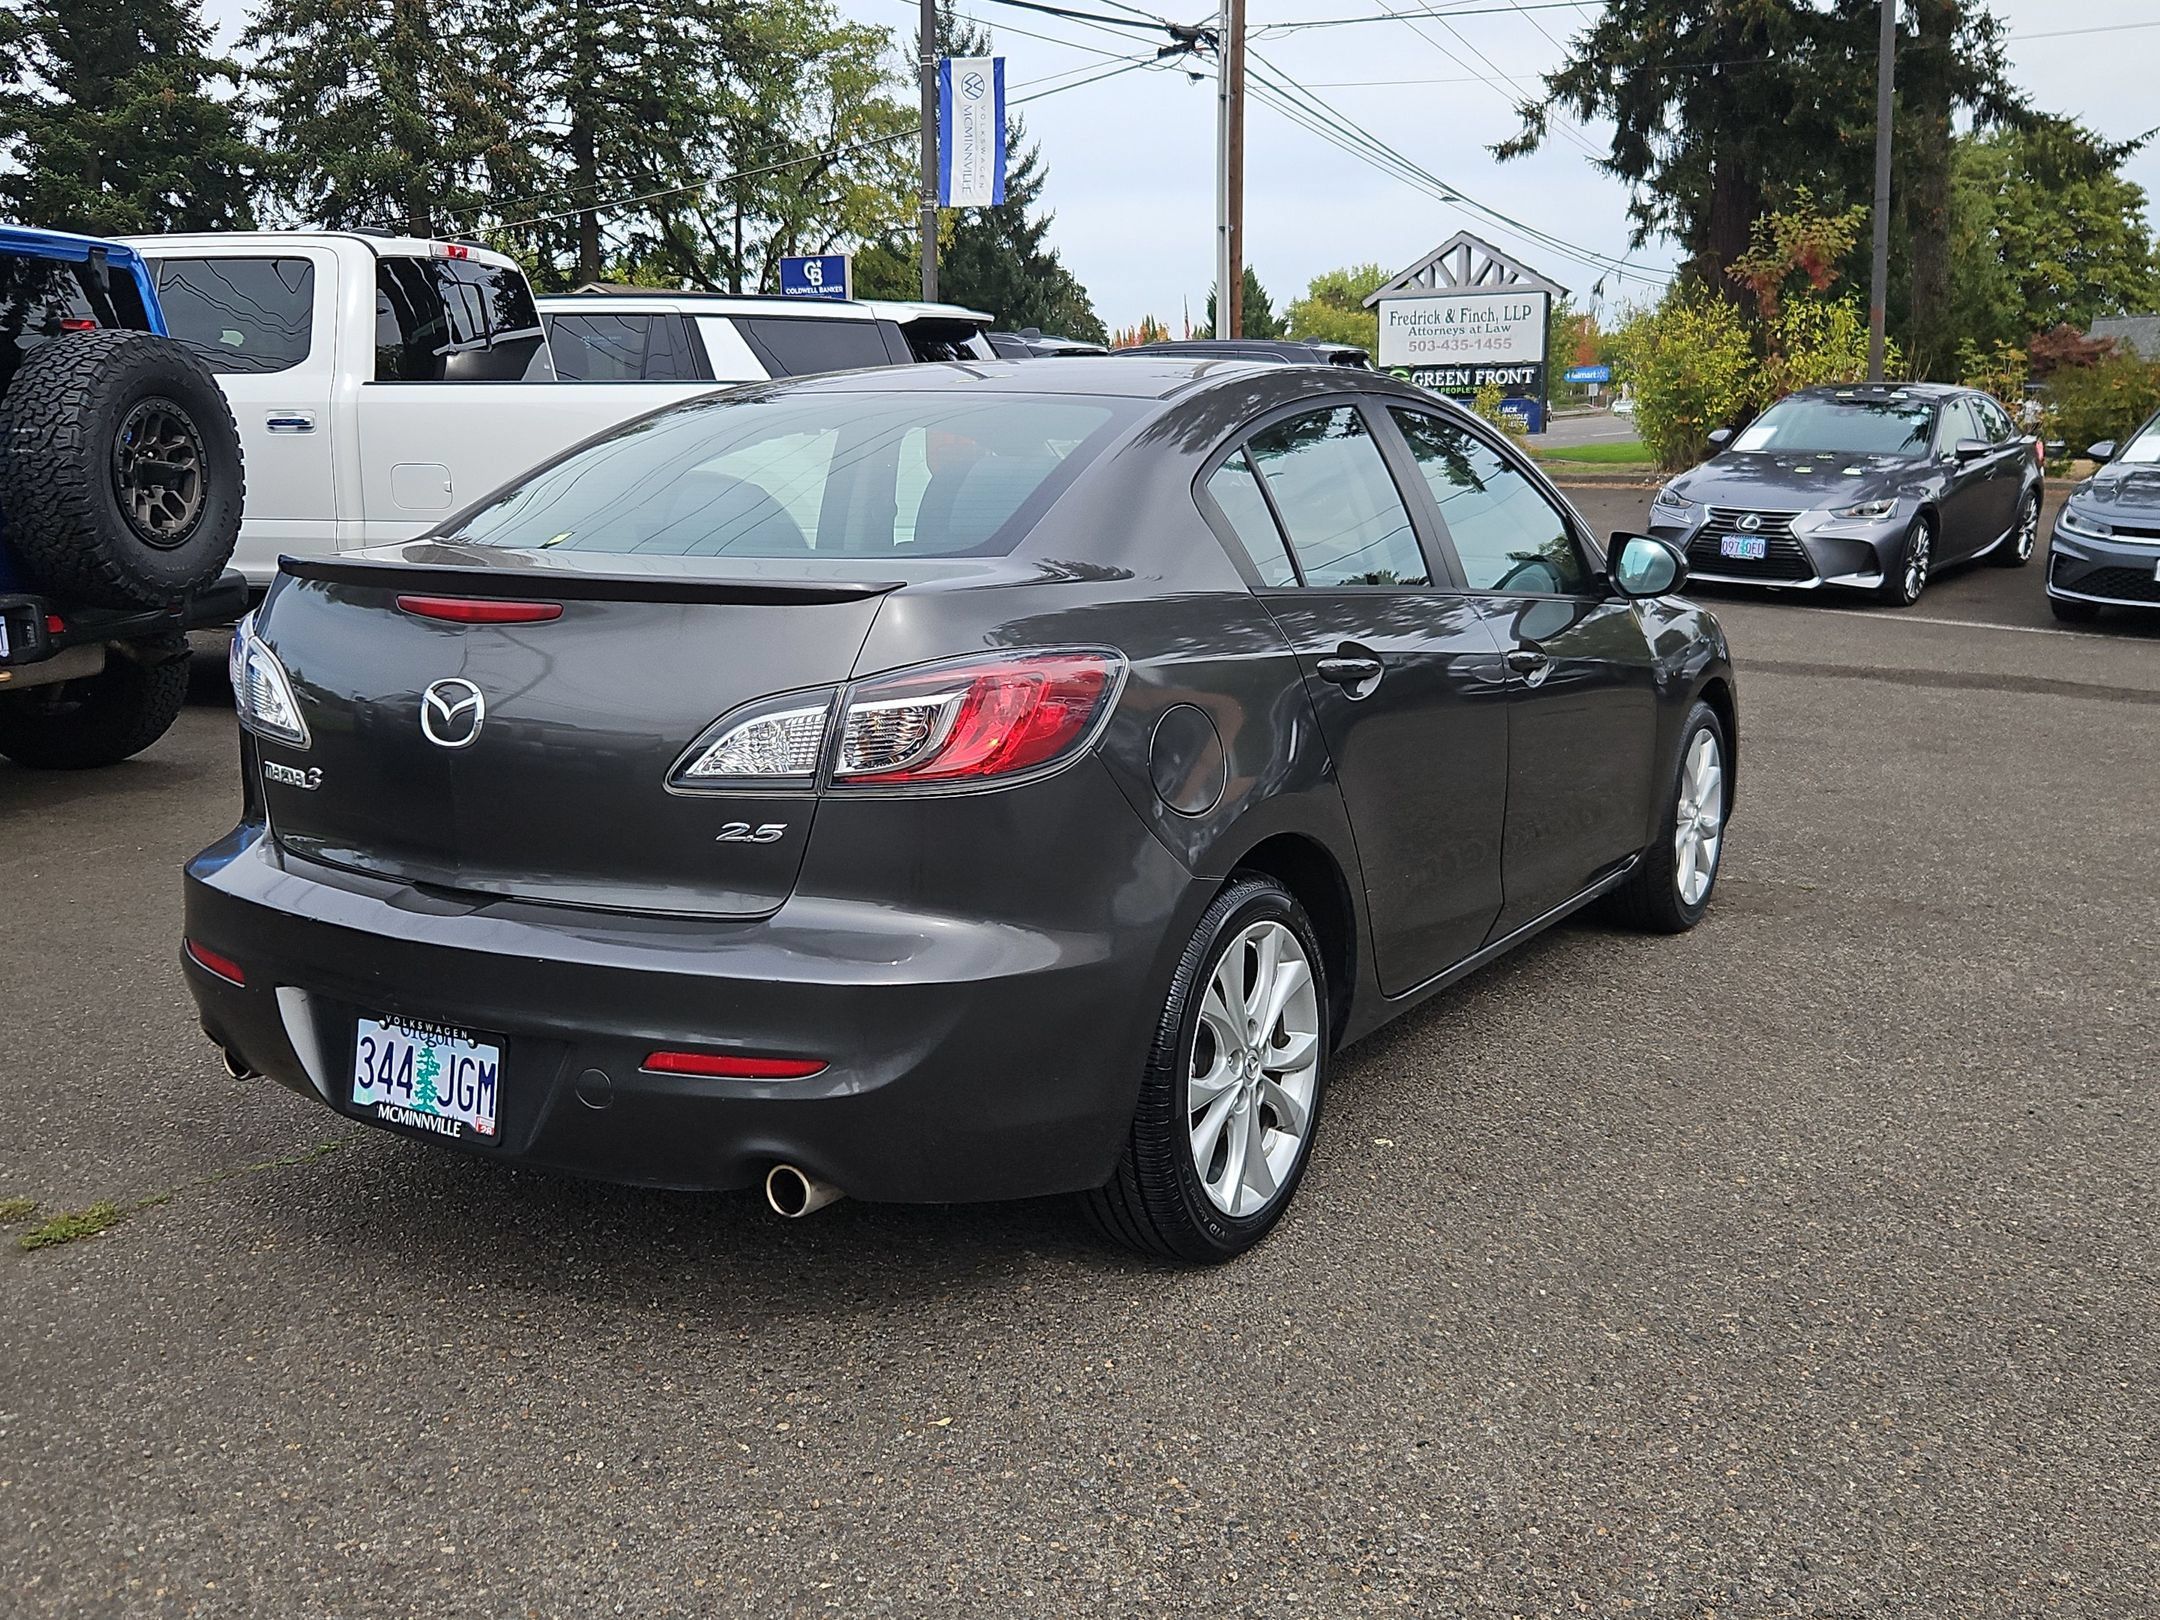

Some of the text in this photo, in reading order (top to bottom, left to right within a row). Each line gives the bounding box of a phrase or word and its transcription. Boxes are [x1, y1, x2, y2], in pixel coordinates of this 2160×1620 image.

[962, 104, 973, 193] MCMINNVILLE
[1389, 305, 1532, 326] Fredrick & Finch, LLP
[1408, 323, 1511, 337] Attorneys at Law
[1408, 338, 1512, 352] 503-435-1455
[1411, 369, 1535, 387] GREEN FRONT
[716, 822, 788, 844] 2.5
[385, 1014, 468, 1039] VOLKSWAGEN
[358, 1036, 497, 1118] 344 JGM
[377, 1103, 462, 1138] MCMINNVILLE
